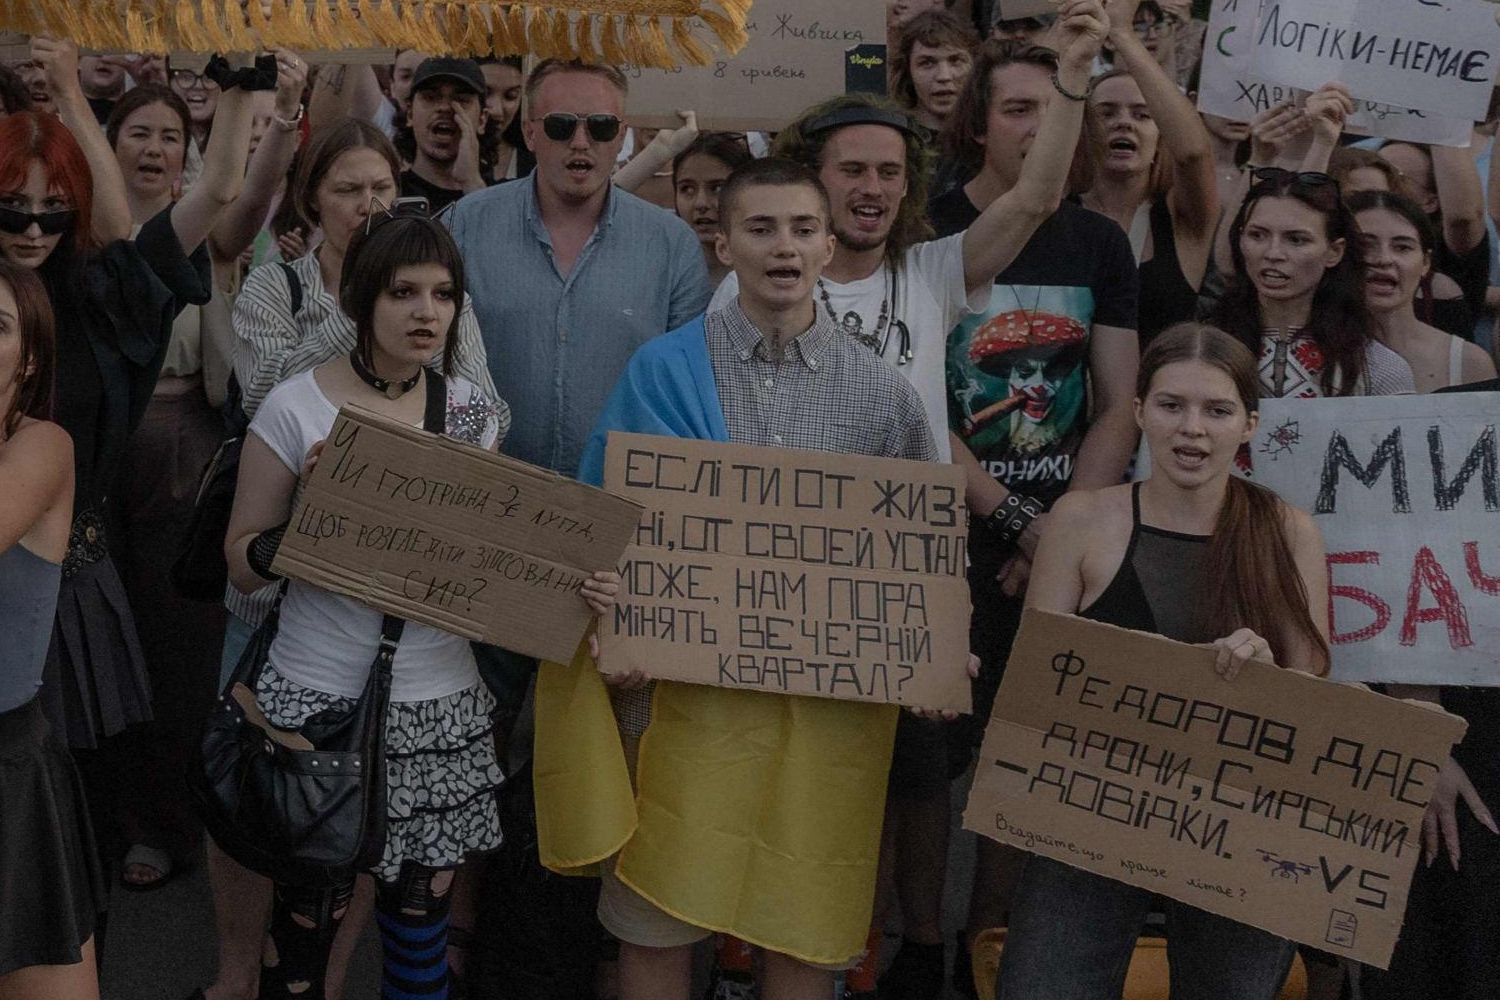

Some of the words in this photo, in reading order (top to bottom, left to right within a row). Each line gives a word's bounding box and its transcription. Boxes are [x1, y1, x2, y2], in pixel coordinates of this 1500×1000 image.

[714, 61, 726, 79] 8
[731, 463, 781, 507] ТИ
[794, 467, 856, 510] ОТ
[1311, 423, 1500, 516] МИ
[296, 502, 350, 549] ЩОБ
[681, 514, 734, 553] ОТ
[402, 568, 488, 613] СИР?
[614, 558, 721, 606] МОЖЕ,
[735, 566, 808, 615] НАМ
[827, 576, 929, 627] ПОРА
[613, 602, 719, 646] МІНЯТЬ
[717, 651, 917, 702] КВАРТАЛ?
[1041, 720, 1203, 799] ДРОНИ,
[1318, 854, 1390, 911] VS
